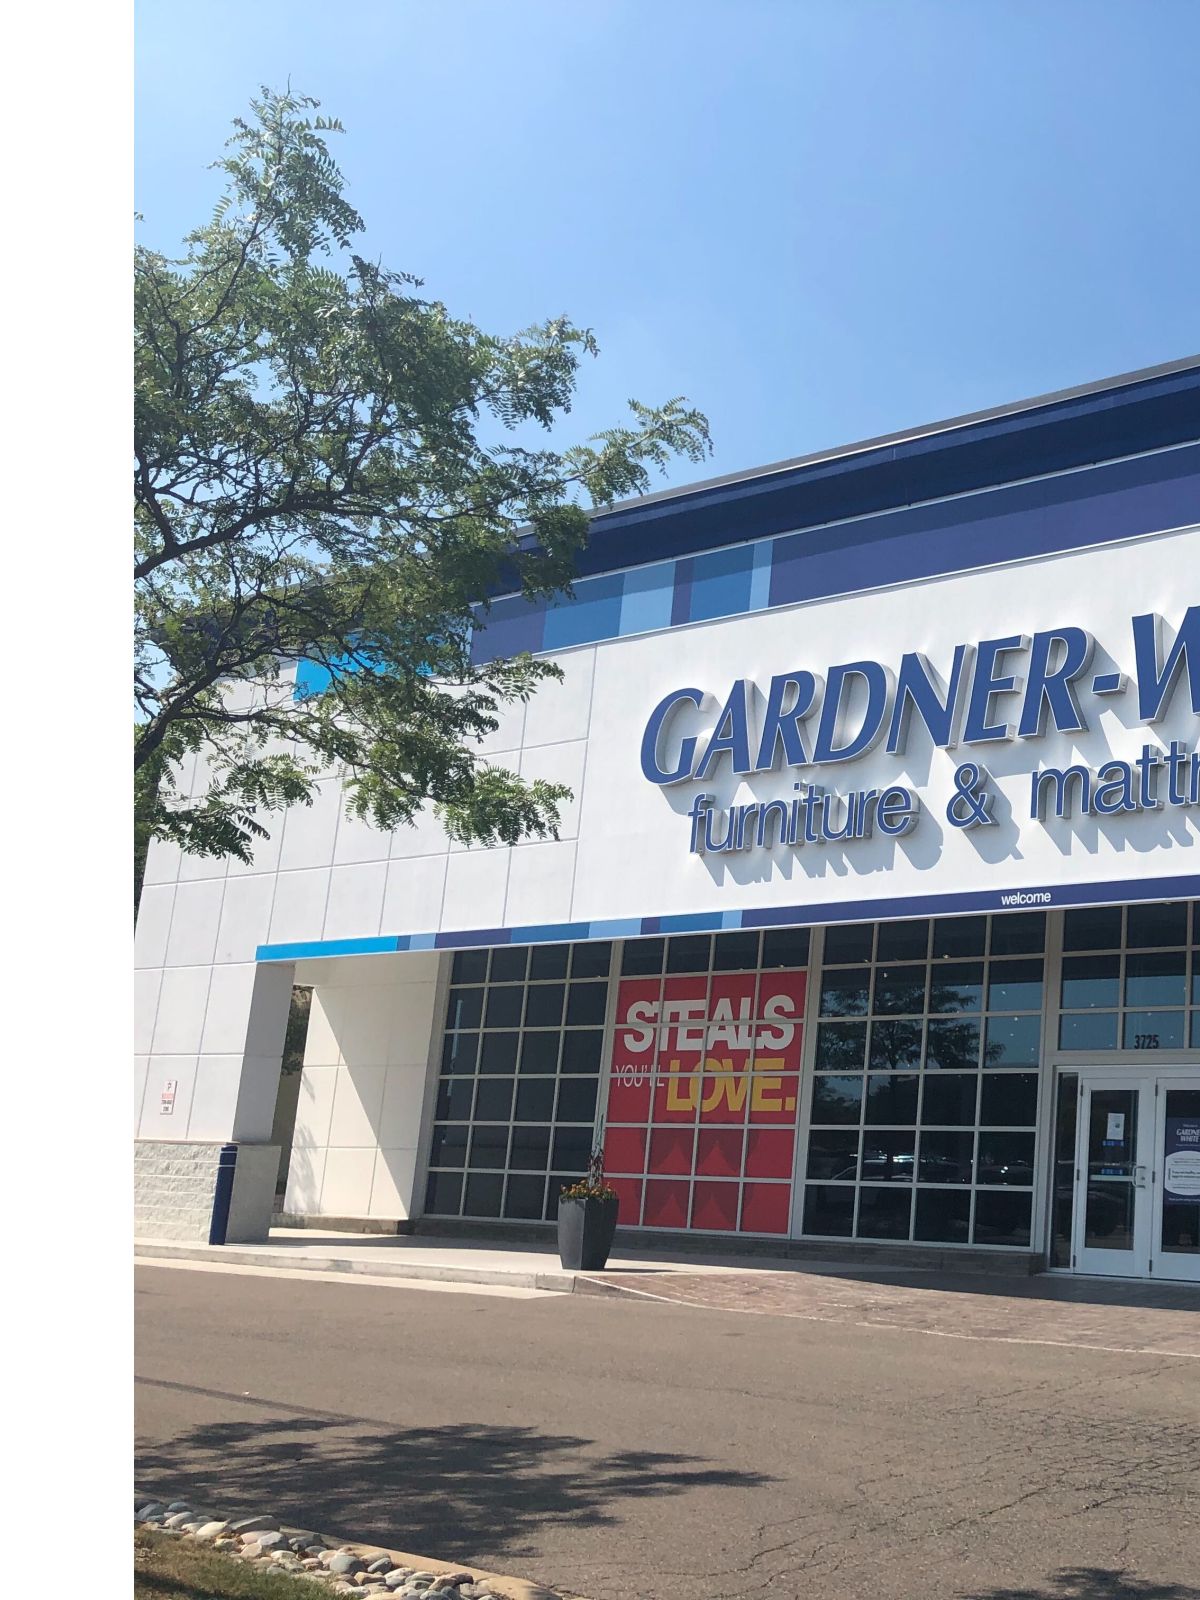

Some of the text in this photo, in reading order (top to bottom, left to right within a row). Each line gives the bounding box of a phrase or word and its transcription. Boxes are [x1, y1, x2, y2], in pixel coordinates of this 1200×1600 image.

[688, 780, 919, 855] furniture
[946, 762, 994, 828] &
[1001, 891, 1051, 905] welcome
[624, 995, 795, 1052] STEALS
[1134, 1034, 1159, 1049] 3725
[667, 1057, 796, 1112] LOVE.
